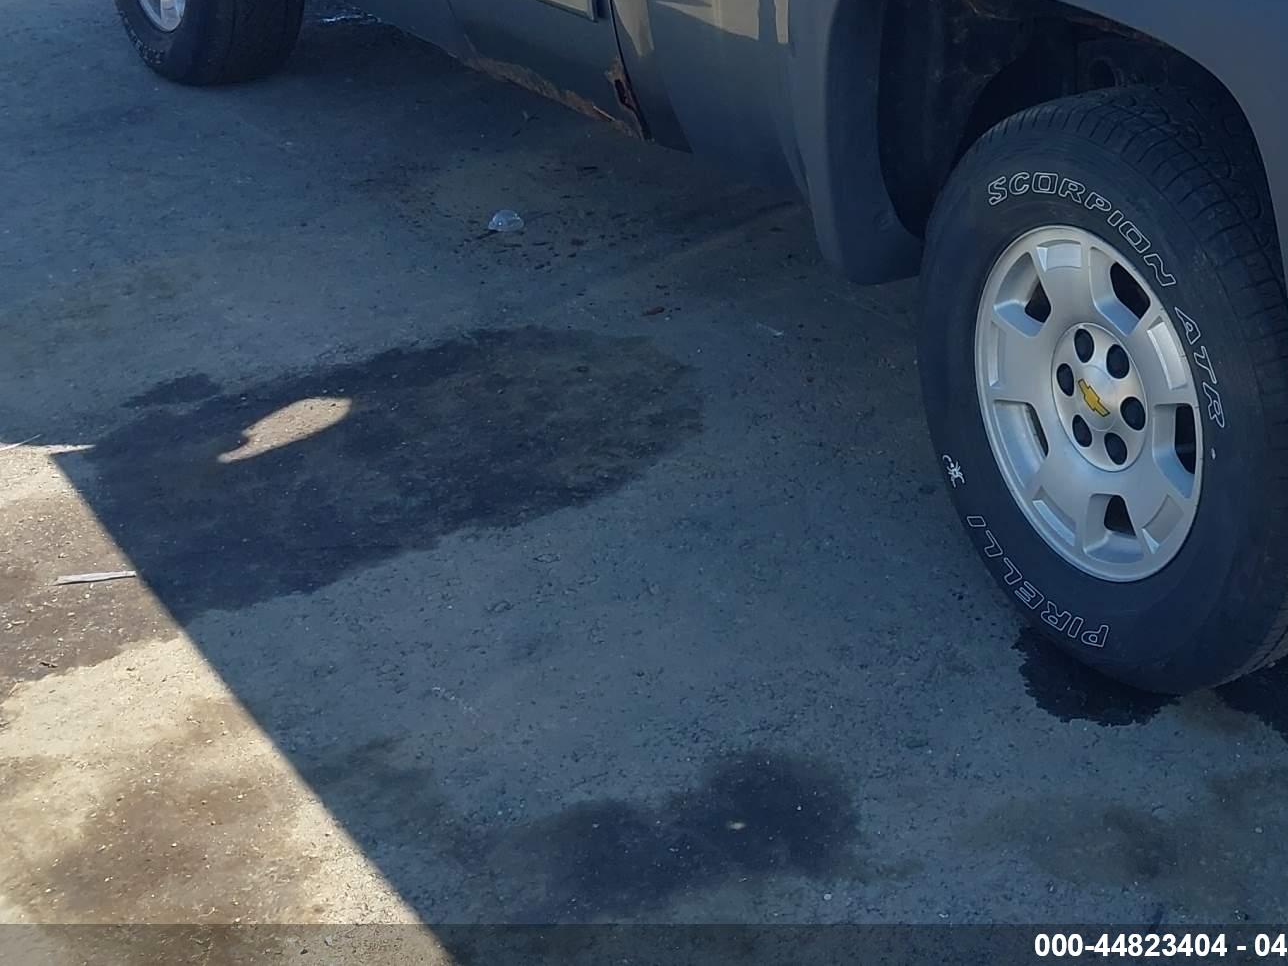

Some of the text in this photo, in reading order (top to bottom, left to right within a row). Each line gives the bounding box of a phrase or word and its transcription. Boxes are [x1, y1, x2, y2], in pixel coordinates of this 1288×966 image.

[987, 171, 1226, 430] SCORPION ATR
[965, 514, 1110, 649] PIRELLI
